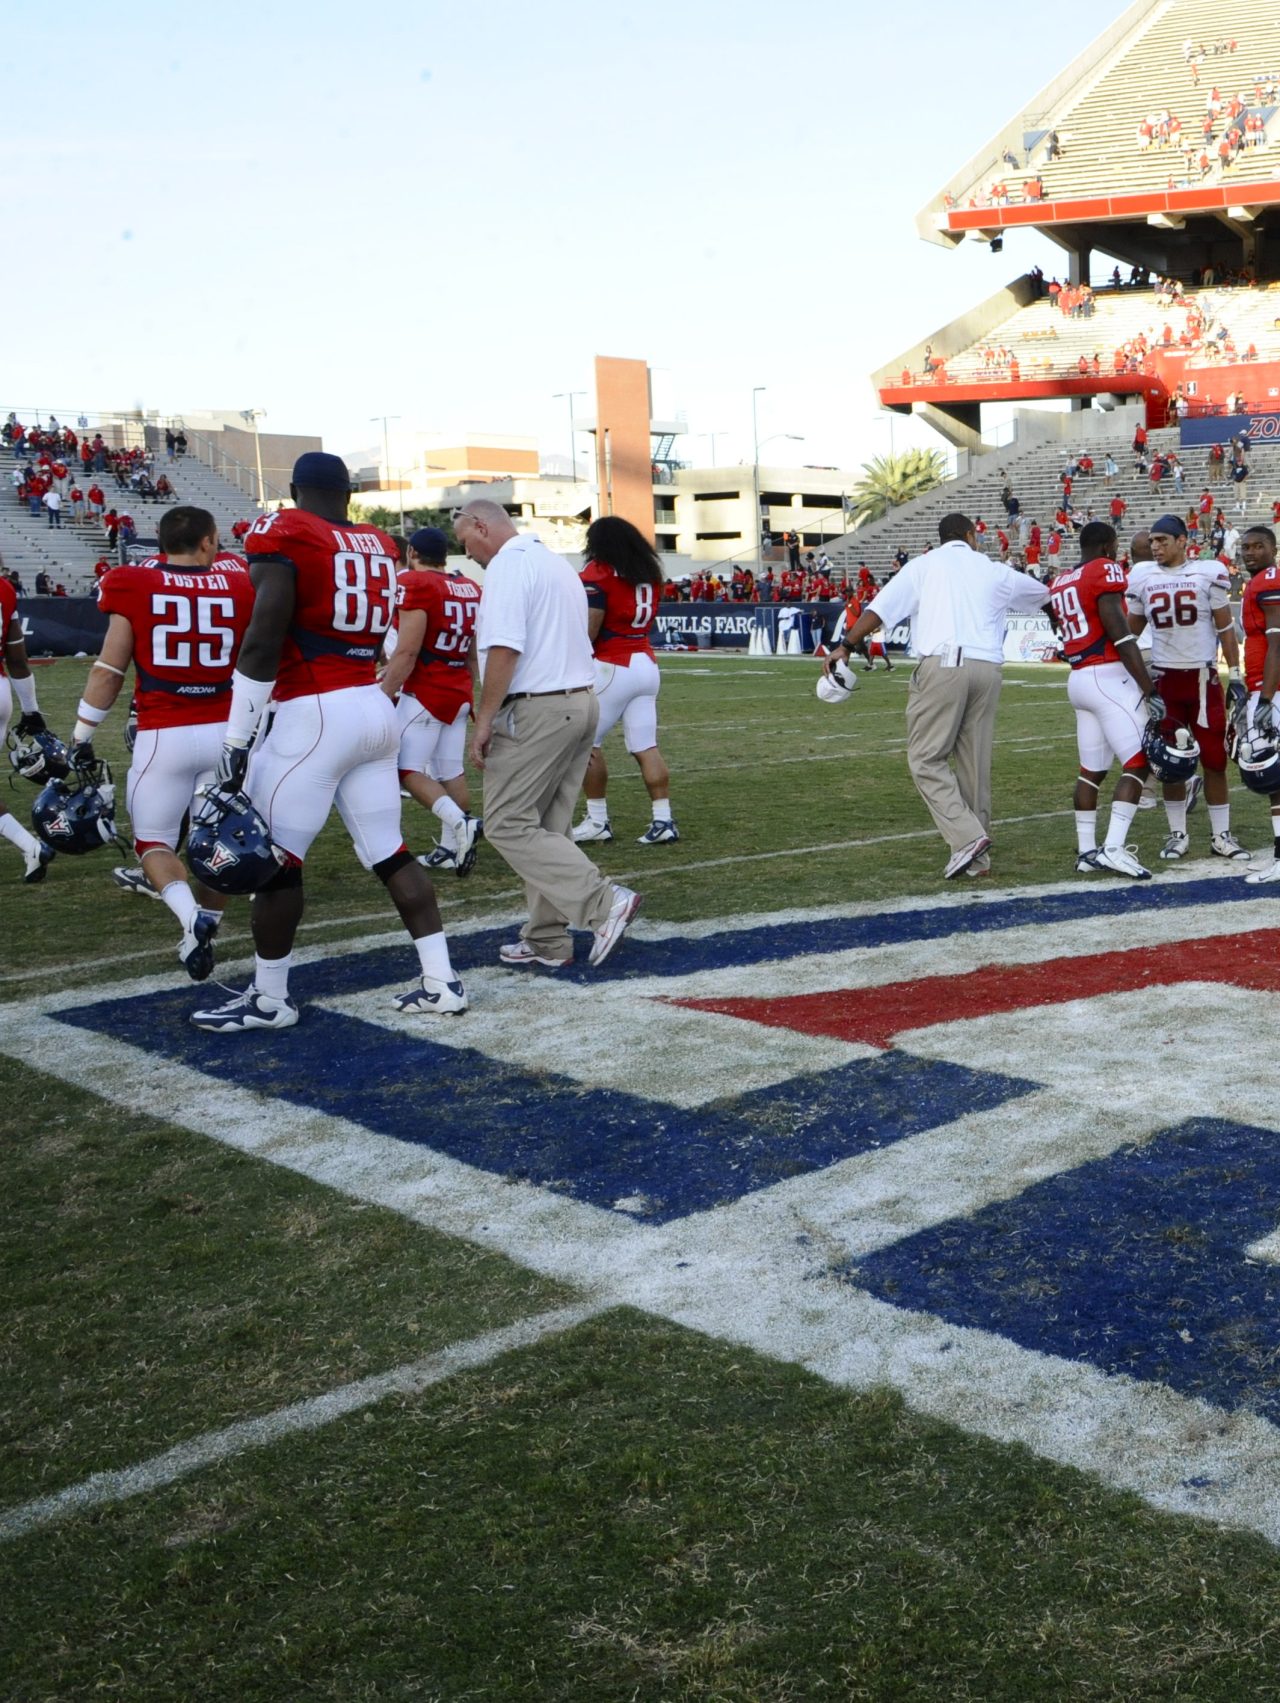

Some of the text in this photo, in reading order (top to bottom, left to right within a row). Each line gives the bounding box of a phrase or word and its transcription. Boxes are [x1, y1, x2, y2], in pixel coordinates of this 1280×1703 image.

[332, 551, 397, 633] 83
[1104, 564, 1124, 582] 39
[1265, 566, 1277, 580] 3
[435, 601, 480, 652] 33
[631, 583, 653, 628] 8
[655, 616, 711, 633] WELLS
[1051, 586, 1089, 641] 39
[1149, 590, 1198, 629] 26
[152, 594, 234, 667] 25
